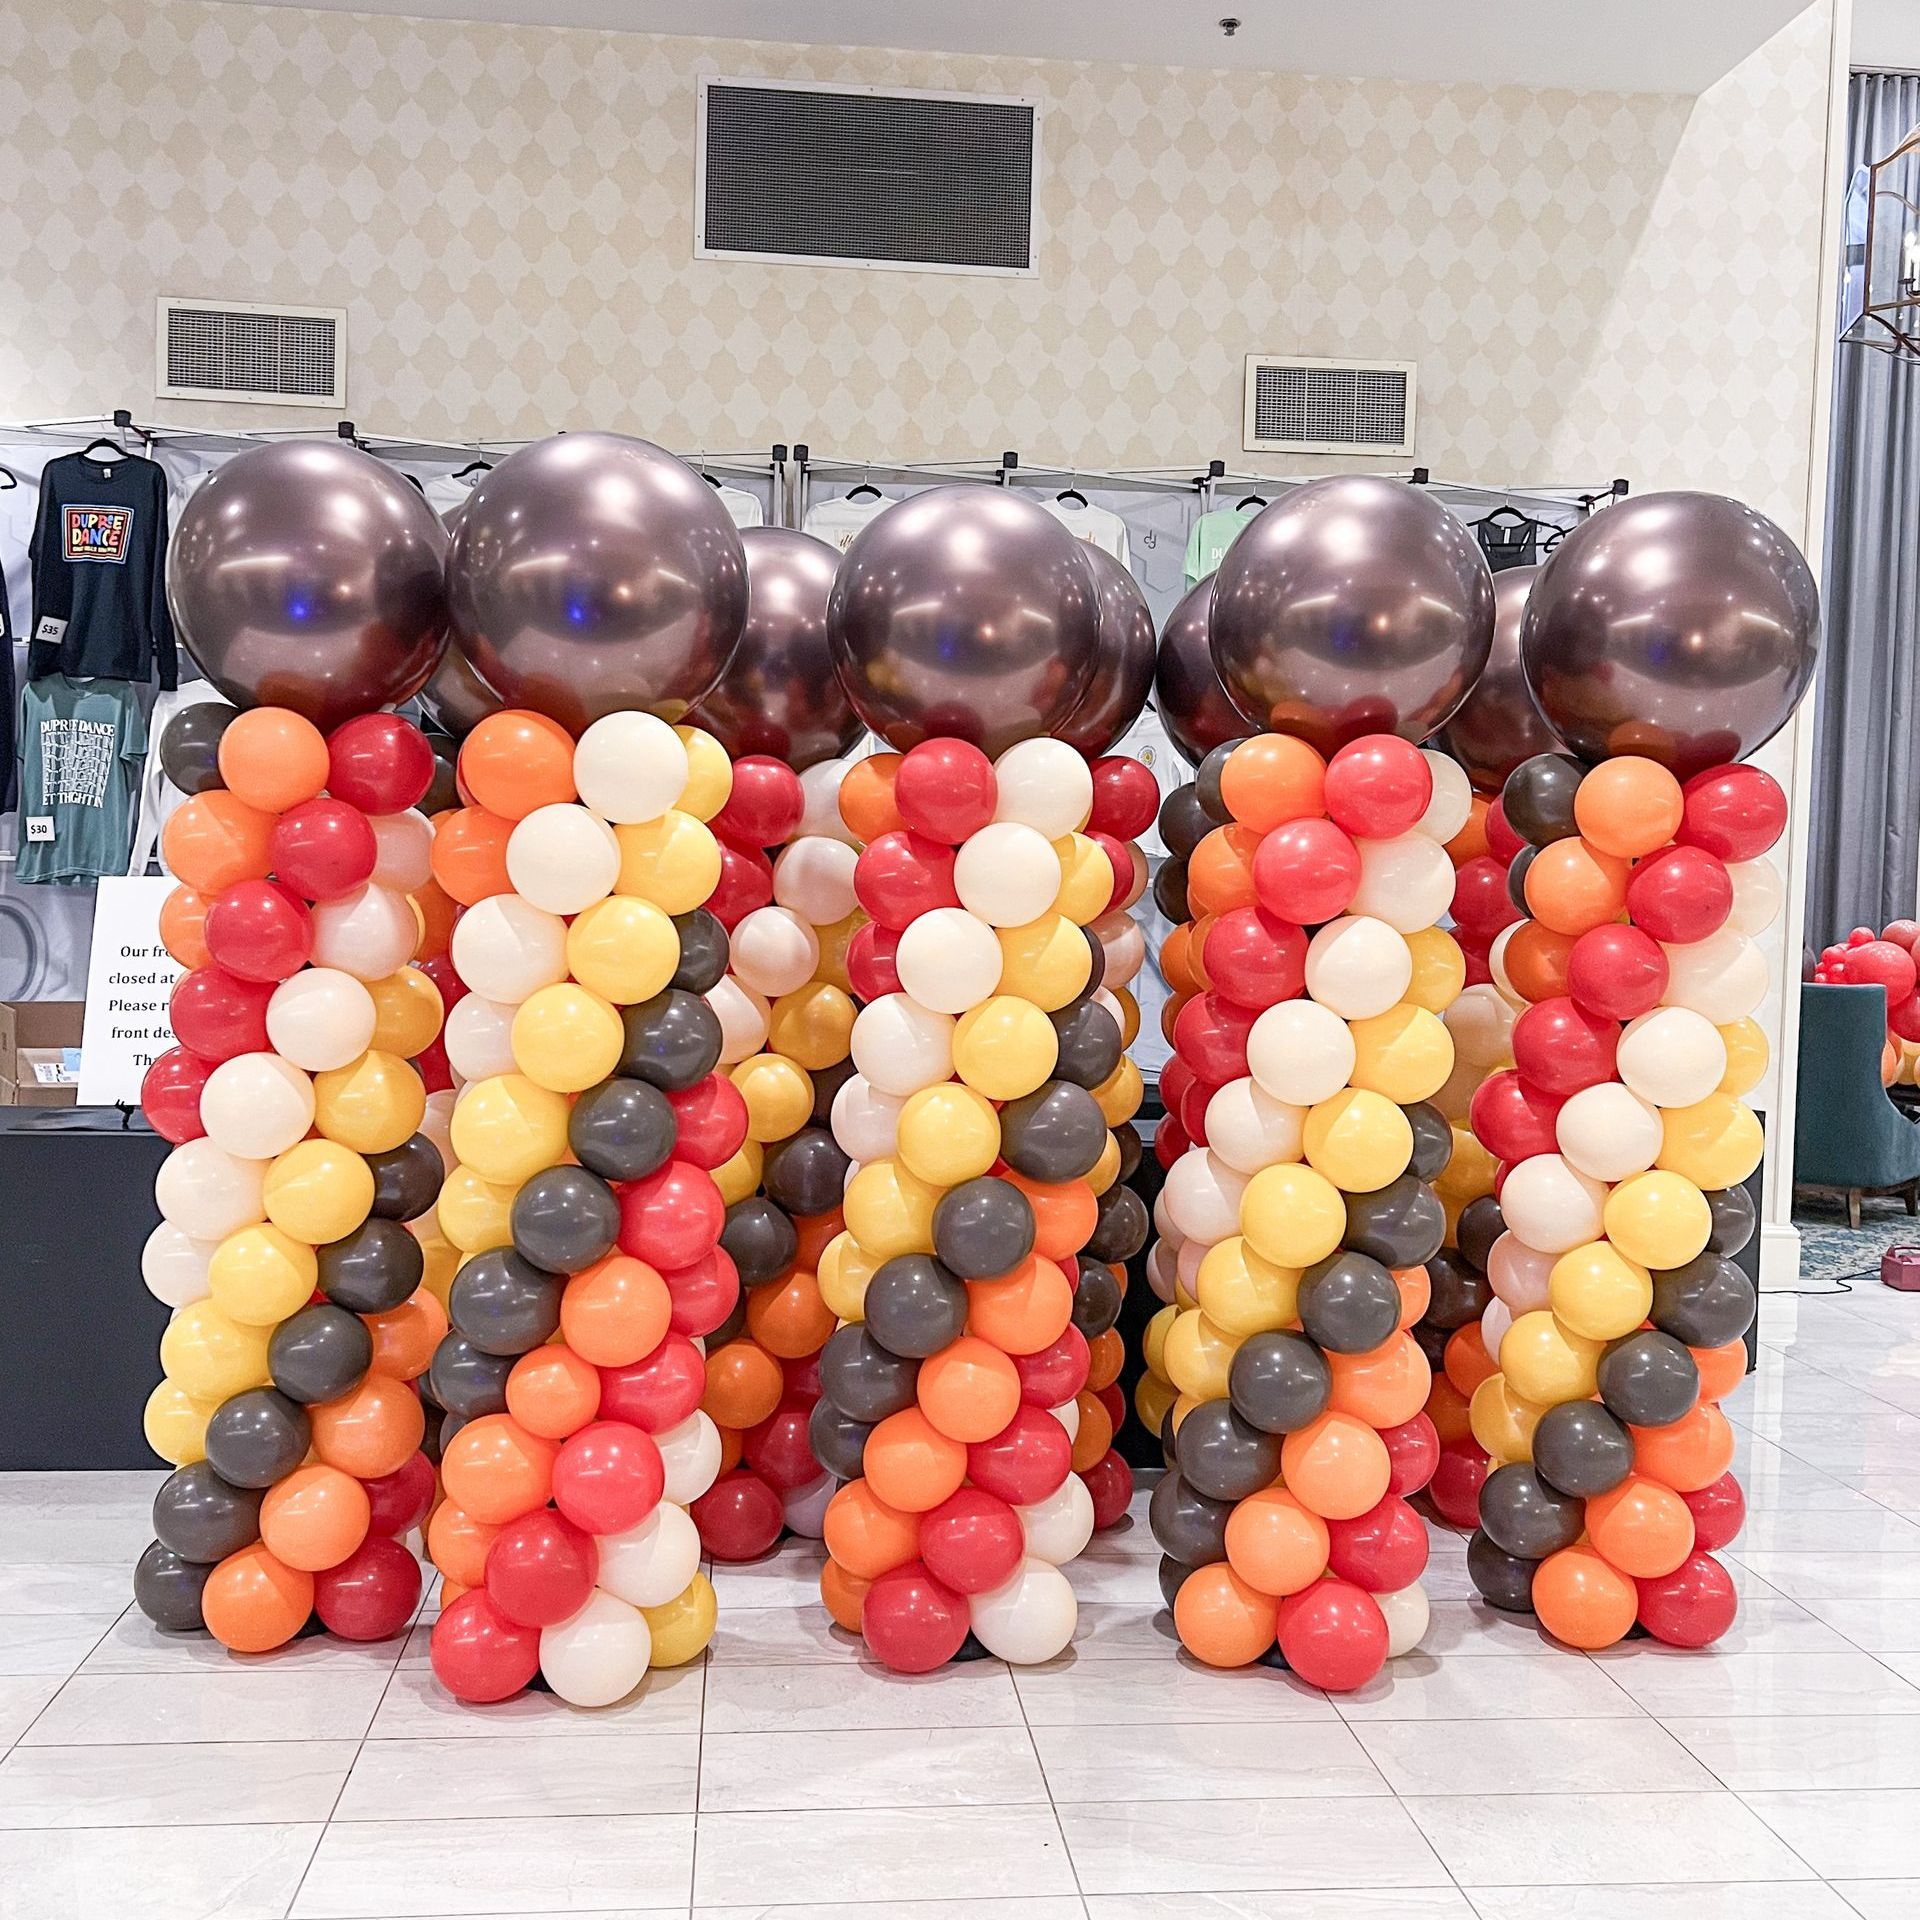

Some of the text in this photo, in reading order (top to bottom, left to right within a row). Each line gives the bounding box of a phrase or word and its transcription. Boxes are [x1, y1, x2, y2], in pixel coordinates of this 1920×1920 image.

[71, 513, 124, 530] DUPREE
[71, 527, 120, 547] DANCE
[42, 623, 59, 636] $35
[78, 720, 116, 737] DANCE
[30, 825, 47, 834] $30
[120, 946, 149, 957] Our
[109, 972, 175, 984] closed at
[109, 999, 169, 1011] Please r
[111, 1026, 149, 1038] front
[132, 1053, 158, 1066] Th
